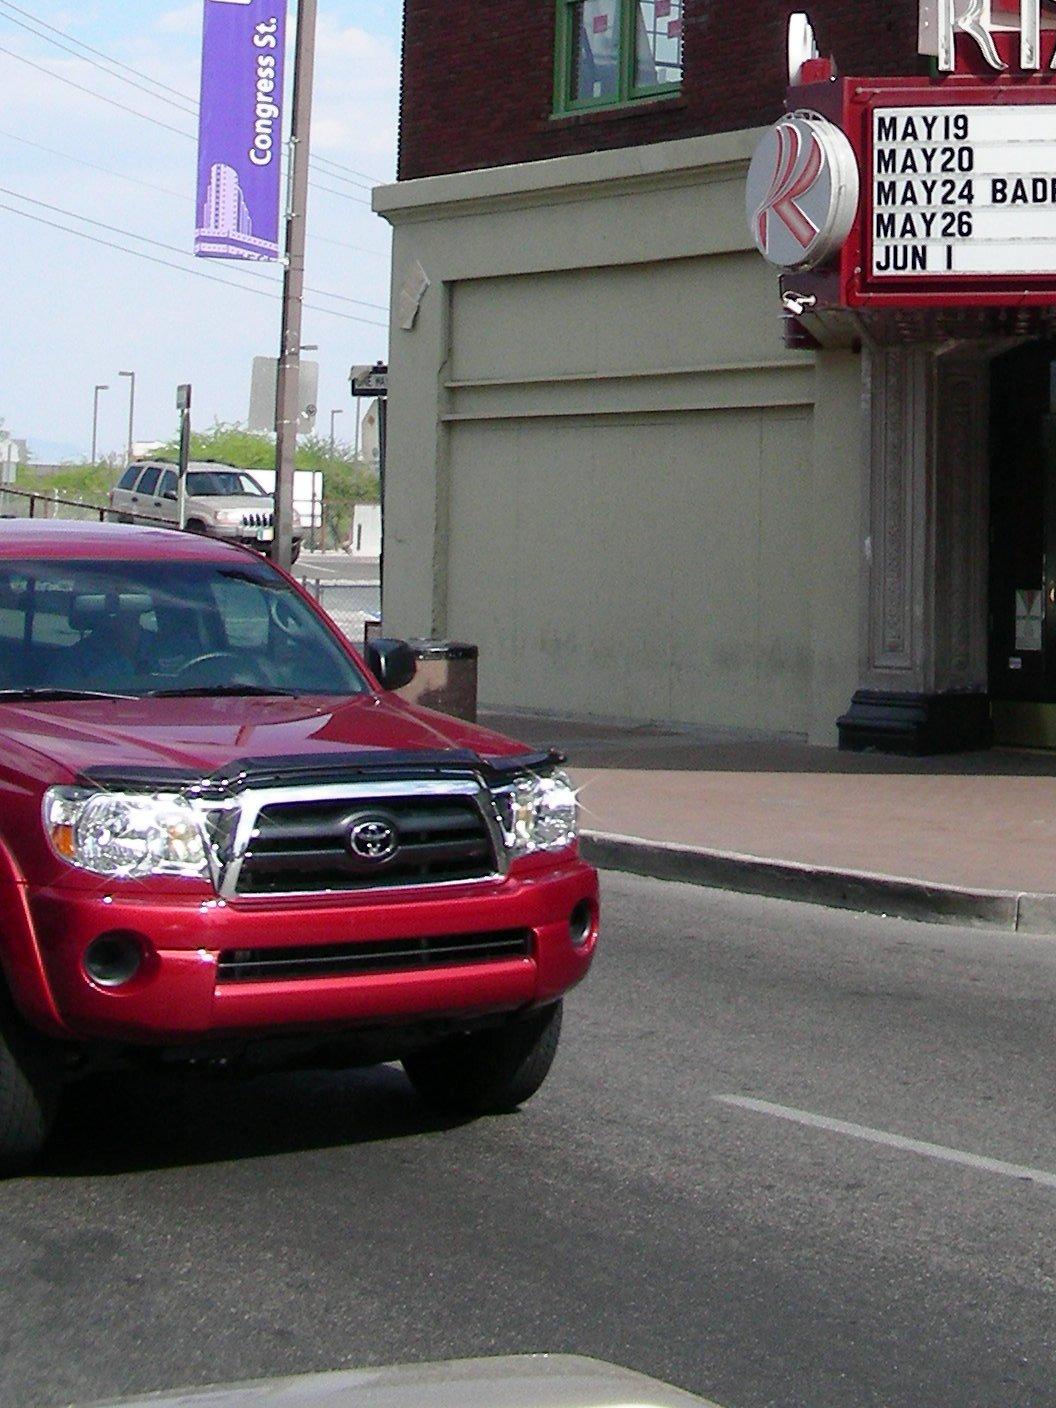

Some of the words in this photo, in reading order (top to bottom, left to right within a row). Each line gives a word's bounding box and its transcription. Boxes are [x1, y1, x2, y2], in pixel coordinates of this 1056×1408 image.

[252, 16, 279, 49] St.
[248, 53, 281, 167] Congress
[875, 244, 927, 272] JUN
[945, 244, 954, 271] 1
